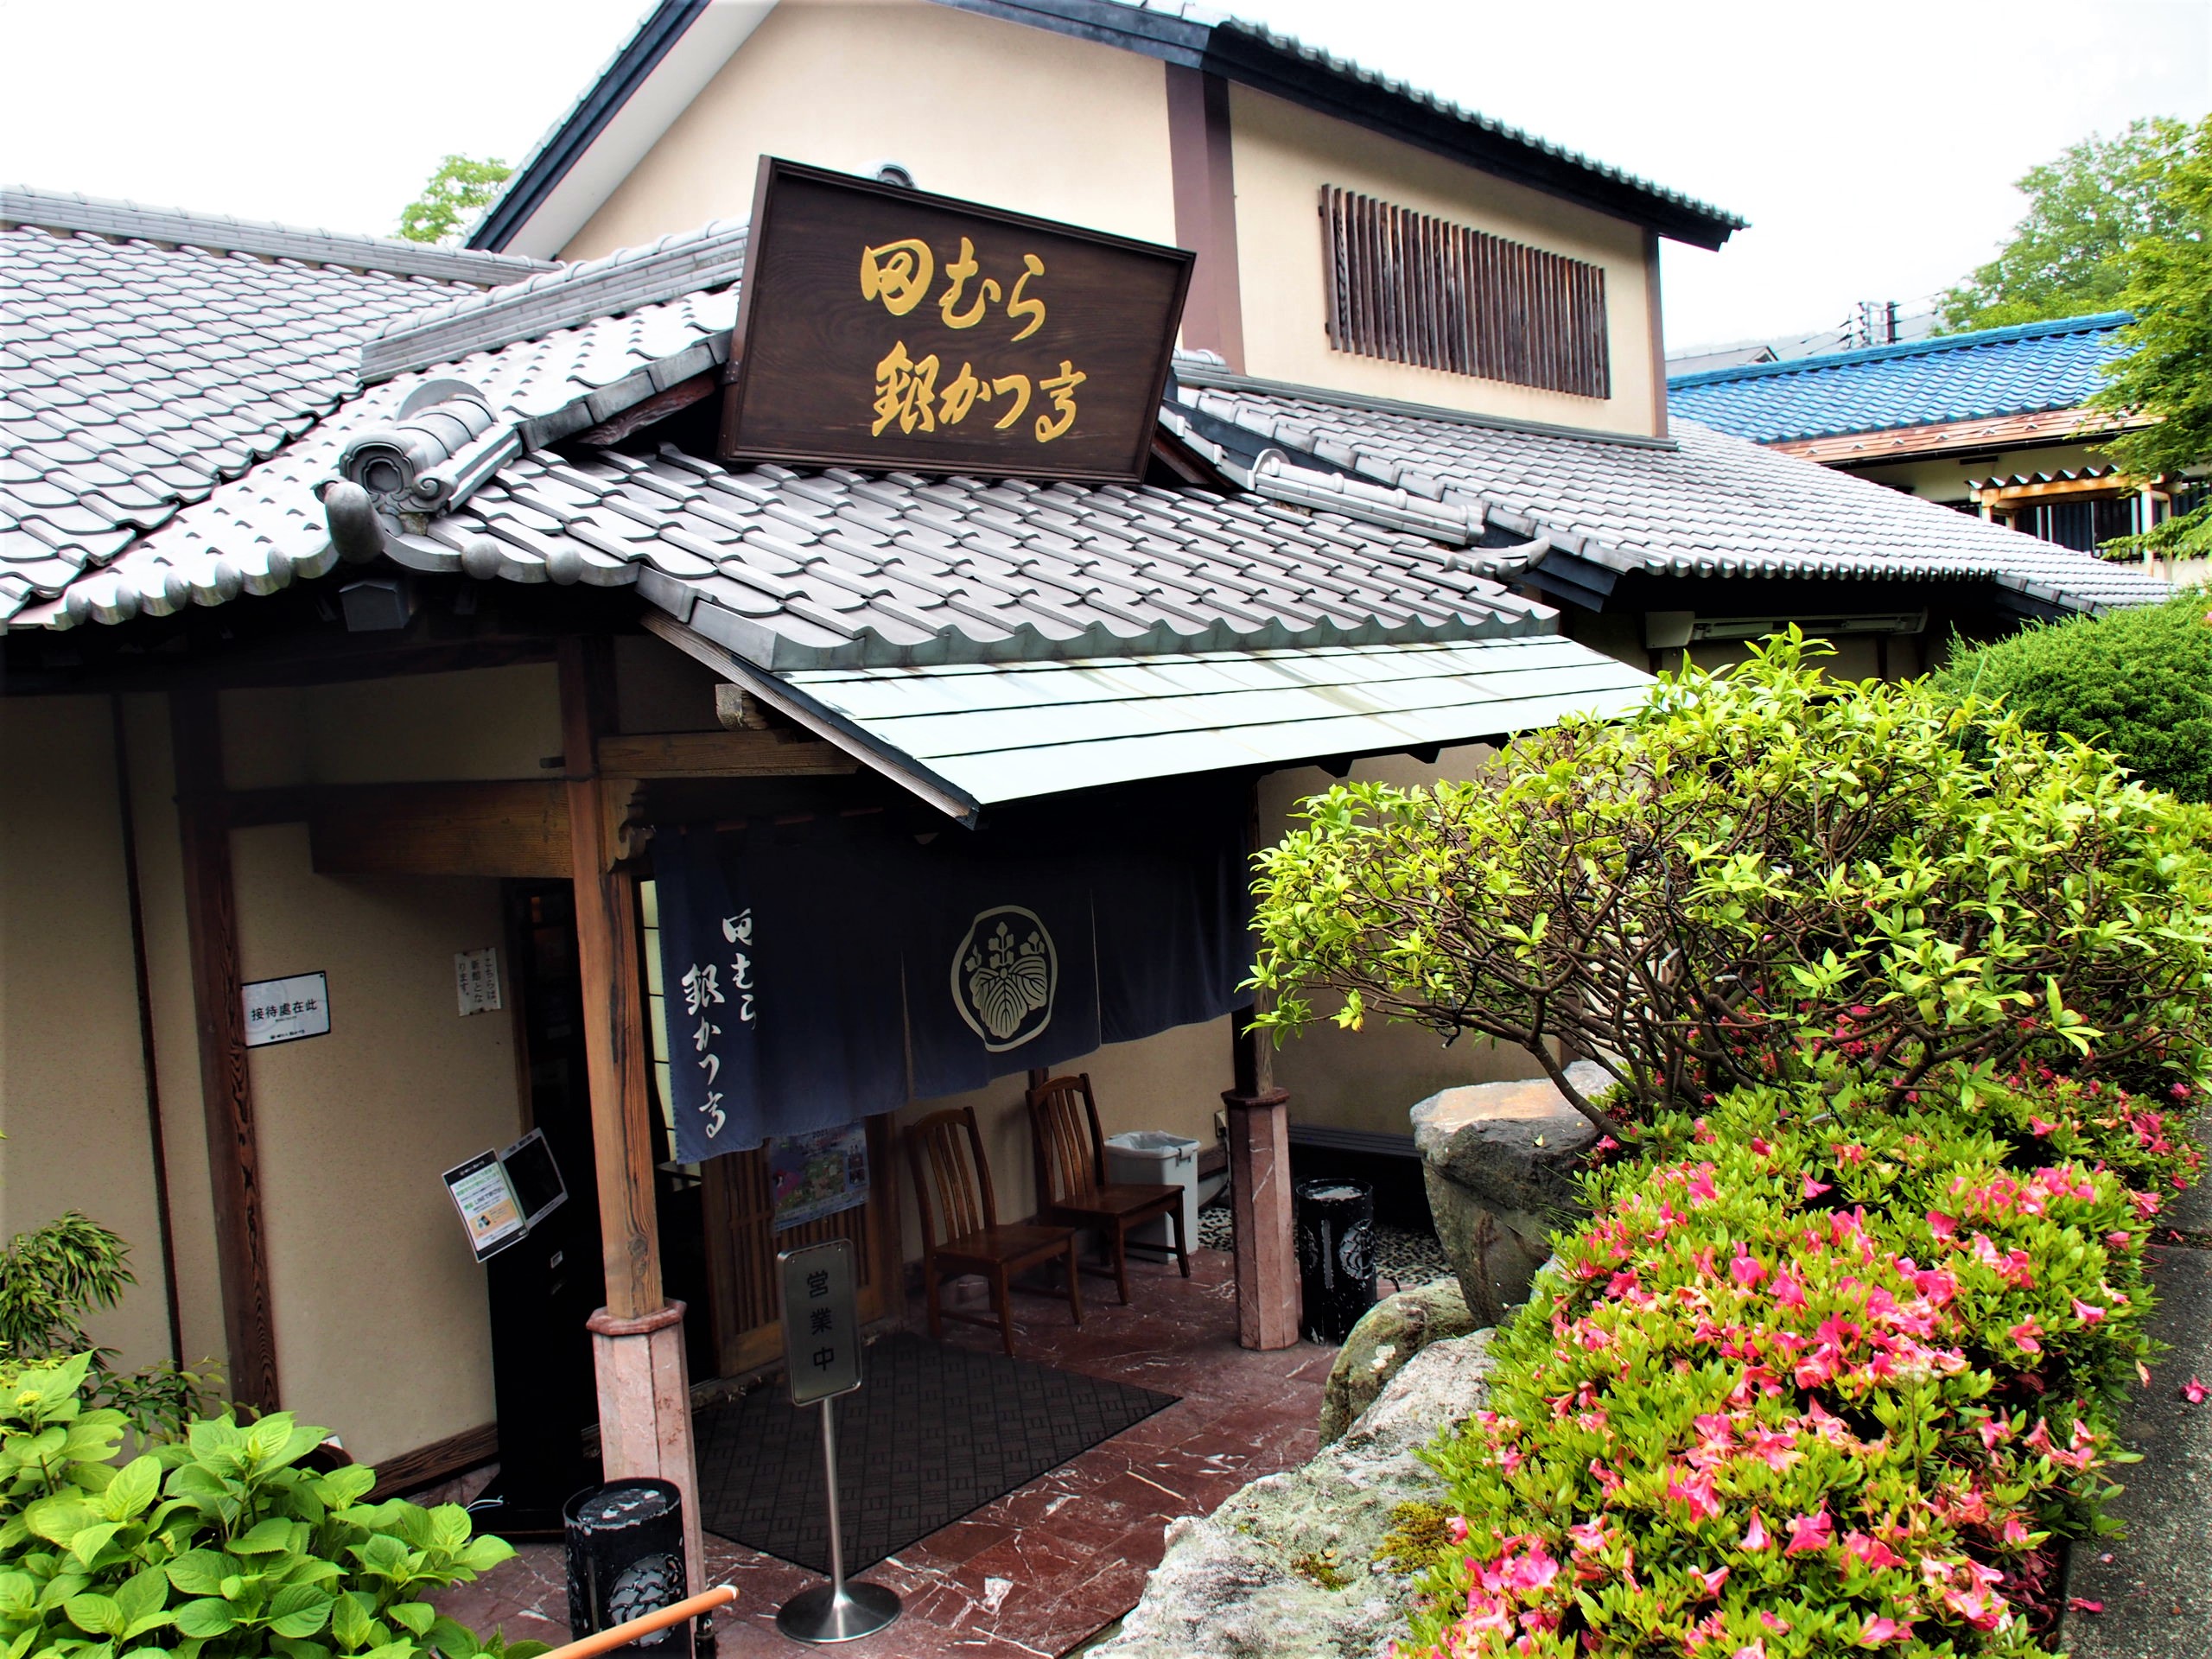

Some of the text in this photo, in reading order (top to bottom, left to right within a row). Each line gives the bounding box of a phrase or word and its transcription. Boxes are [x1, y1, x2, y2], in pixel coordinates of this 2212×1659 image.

[860, 236, 1046, 342] 田むら
[871, 340, 1088, 443] 銀かつ亭
[251, 998, 318, 1021] 接待處在此
[806, 1268, 835, 1372] 営業中
